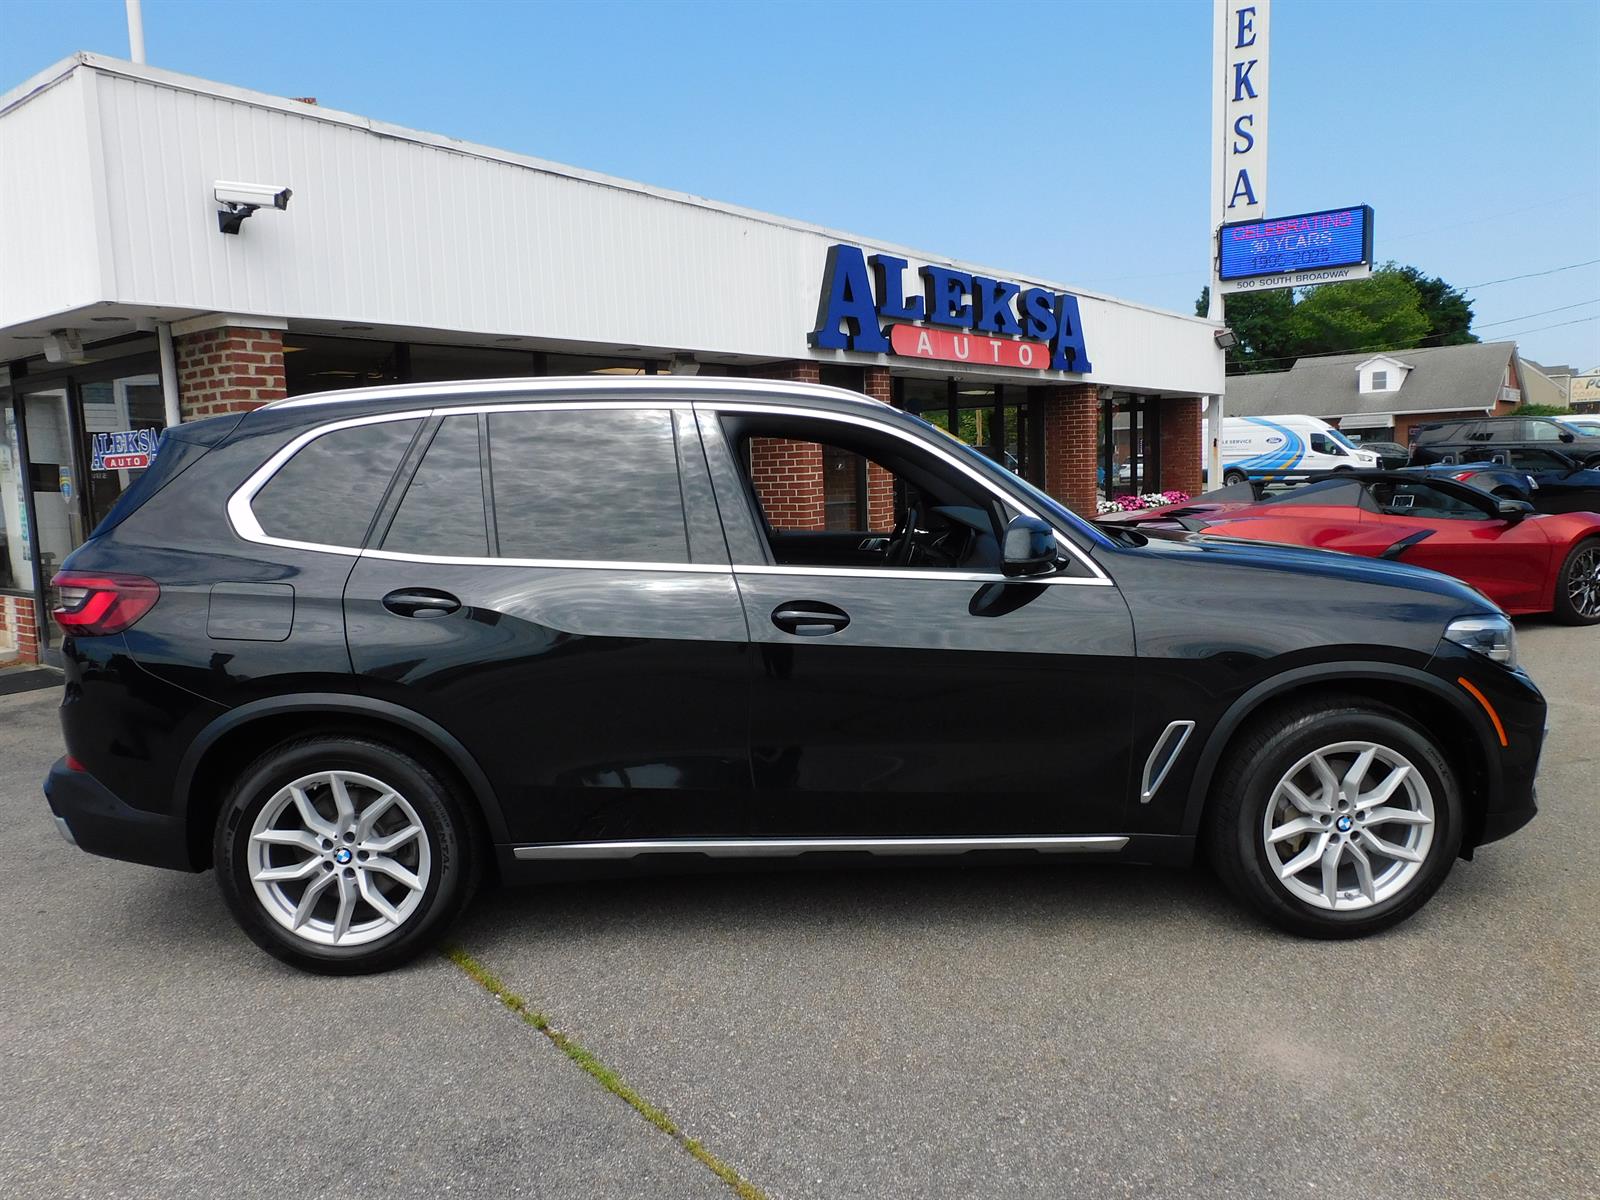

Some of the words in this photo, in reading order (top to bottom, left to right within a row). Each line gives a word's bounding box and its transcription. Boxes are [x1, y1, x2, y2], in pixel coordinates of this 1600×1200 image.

[1232, 211, 1352, 241] CELEBRATING
[1251, 239, 1269, 254] 30
[1274, 231, 1332, 251] YEARS
[1237, 280, 1255, 289] 500
[1260, 276, 1292, 287] SOUTH
[1296, 270, 1350, 281] BROADWAY
[807, 244, 1092, 374] ALEKSA
[917, 331, 1033, 366] AUTO
[91, 427, 160, 471] ALEKSA
[110, 457, 141, 467] AUTO
